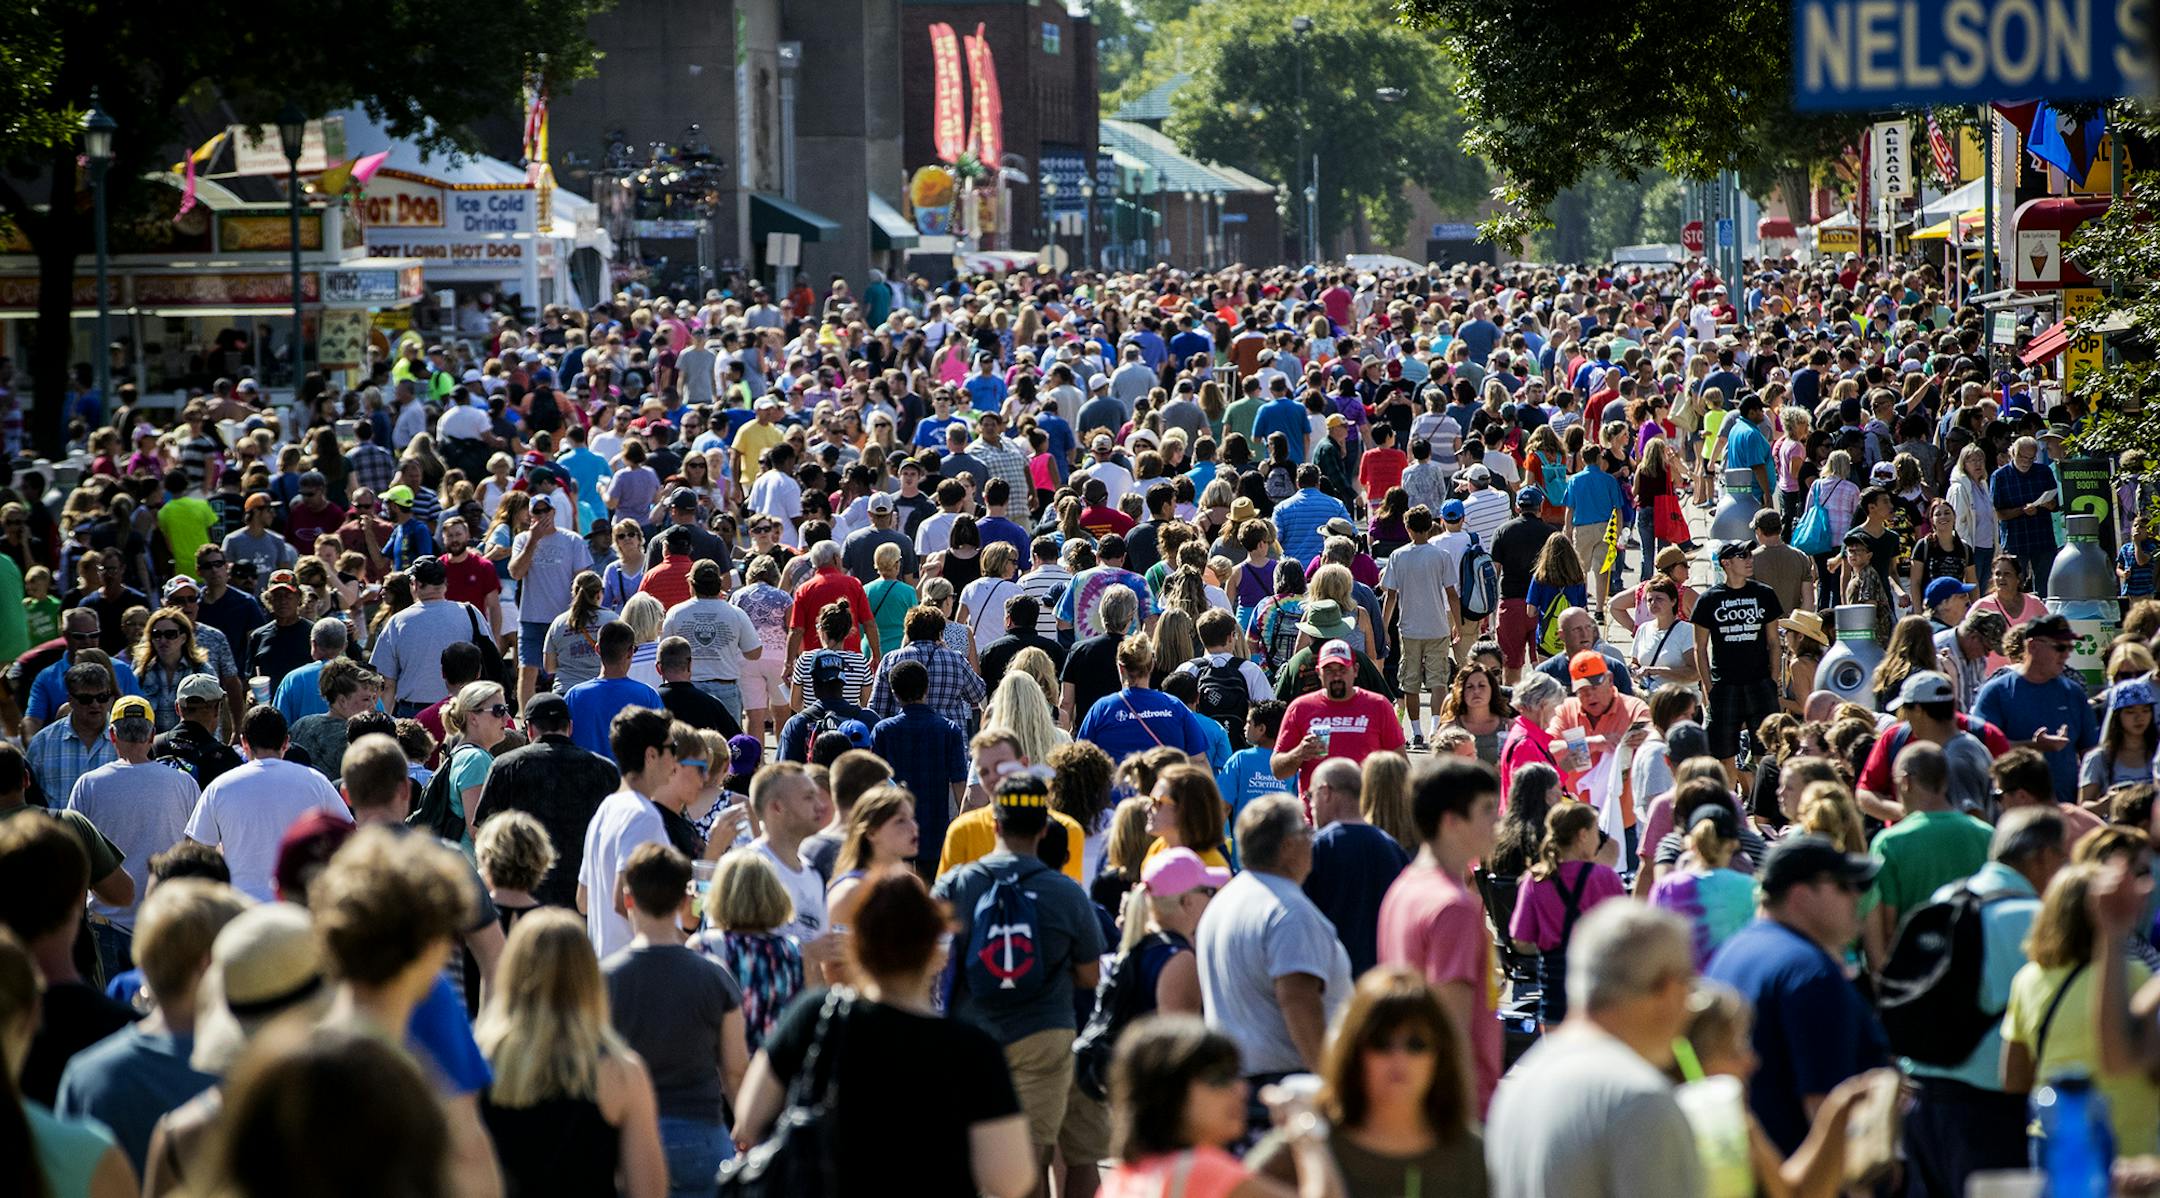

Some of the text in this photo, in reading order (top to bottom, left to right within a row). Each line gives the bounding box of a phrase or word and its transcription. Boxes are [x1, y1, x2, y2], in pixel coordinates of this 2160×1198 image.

[1803, 0, 2157, 92] NELSON S
[1885, 127, 1901, 193] ALPACAS
[367, 197, 391, 222] OT
[456, 194, 524, 212] Ice Cold
[464, 215, 517, 231] Drinks
[1684, 230, 1704, 243] STO
[404, 244, 447, 257] LONG
[451, 244, 483, 257] HOT
[487, 243, 521, 257] DOG
[2069, 339, 2100, 354] POP
[2063, 470, 2109, 479] INFORMATION
[2076, 481, 2099, 489] BOOTH
[1714, 606, 1766, 624] Google
[1309, 716, 1353, 727] CASE
